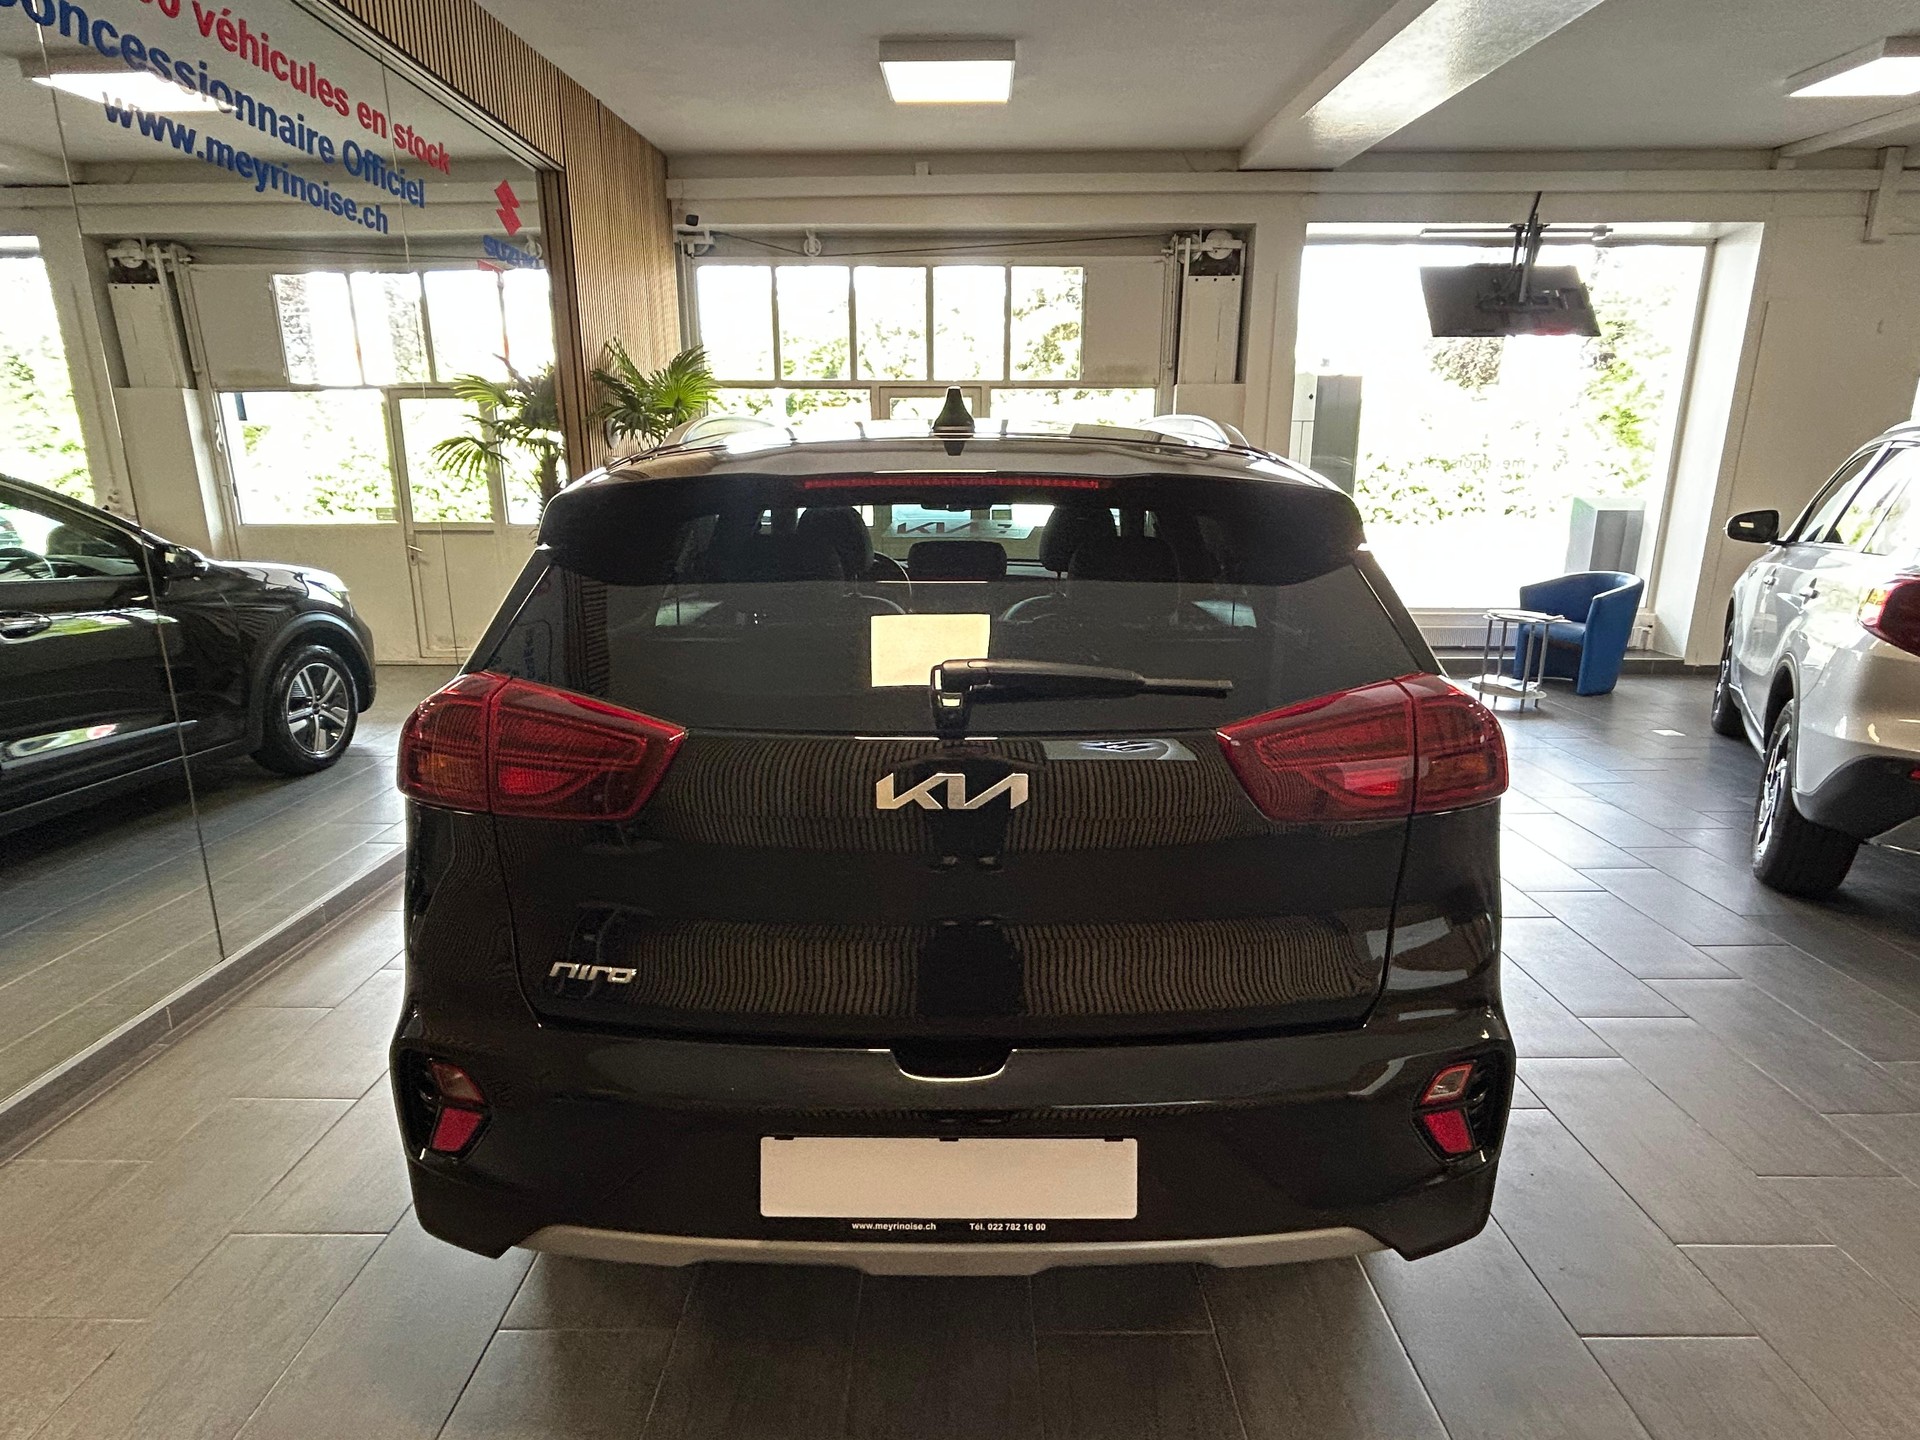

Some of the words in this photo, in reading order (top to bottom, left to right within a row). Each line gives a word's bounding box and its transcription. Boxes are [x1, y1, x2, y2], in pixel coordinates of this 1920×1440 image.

[0, 0, 335, 164] oncessionnaire
[342, 139, 425, 208] Officiel
[192, 1, 350, 117] véhicules
[357, 101, 387, 139] en
[394, 123, 450, 176] stock
[103, 92, 388, 234] www.meyrinoise.ch
[876, 772, 1029, 810] KIA
[549, 961, 637, 984] niro
[851, 1222, 937, 1232] www.meyrinoise.ch
[969, 1222, 985, 1231] Tél.
[987, 1223, 1003, 1231] 022
[1005, 1223, 1021, 1231] 782
[1023, 1223, 1034, 1231] 16
[1035, 1223, 1047, 1231] 00
